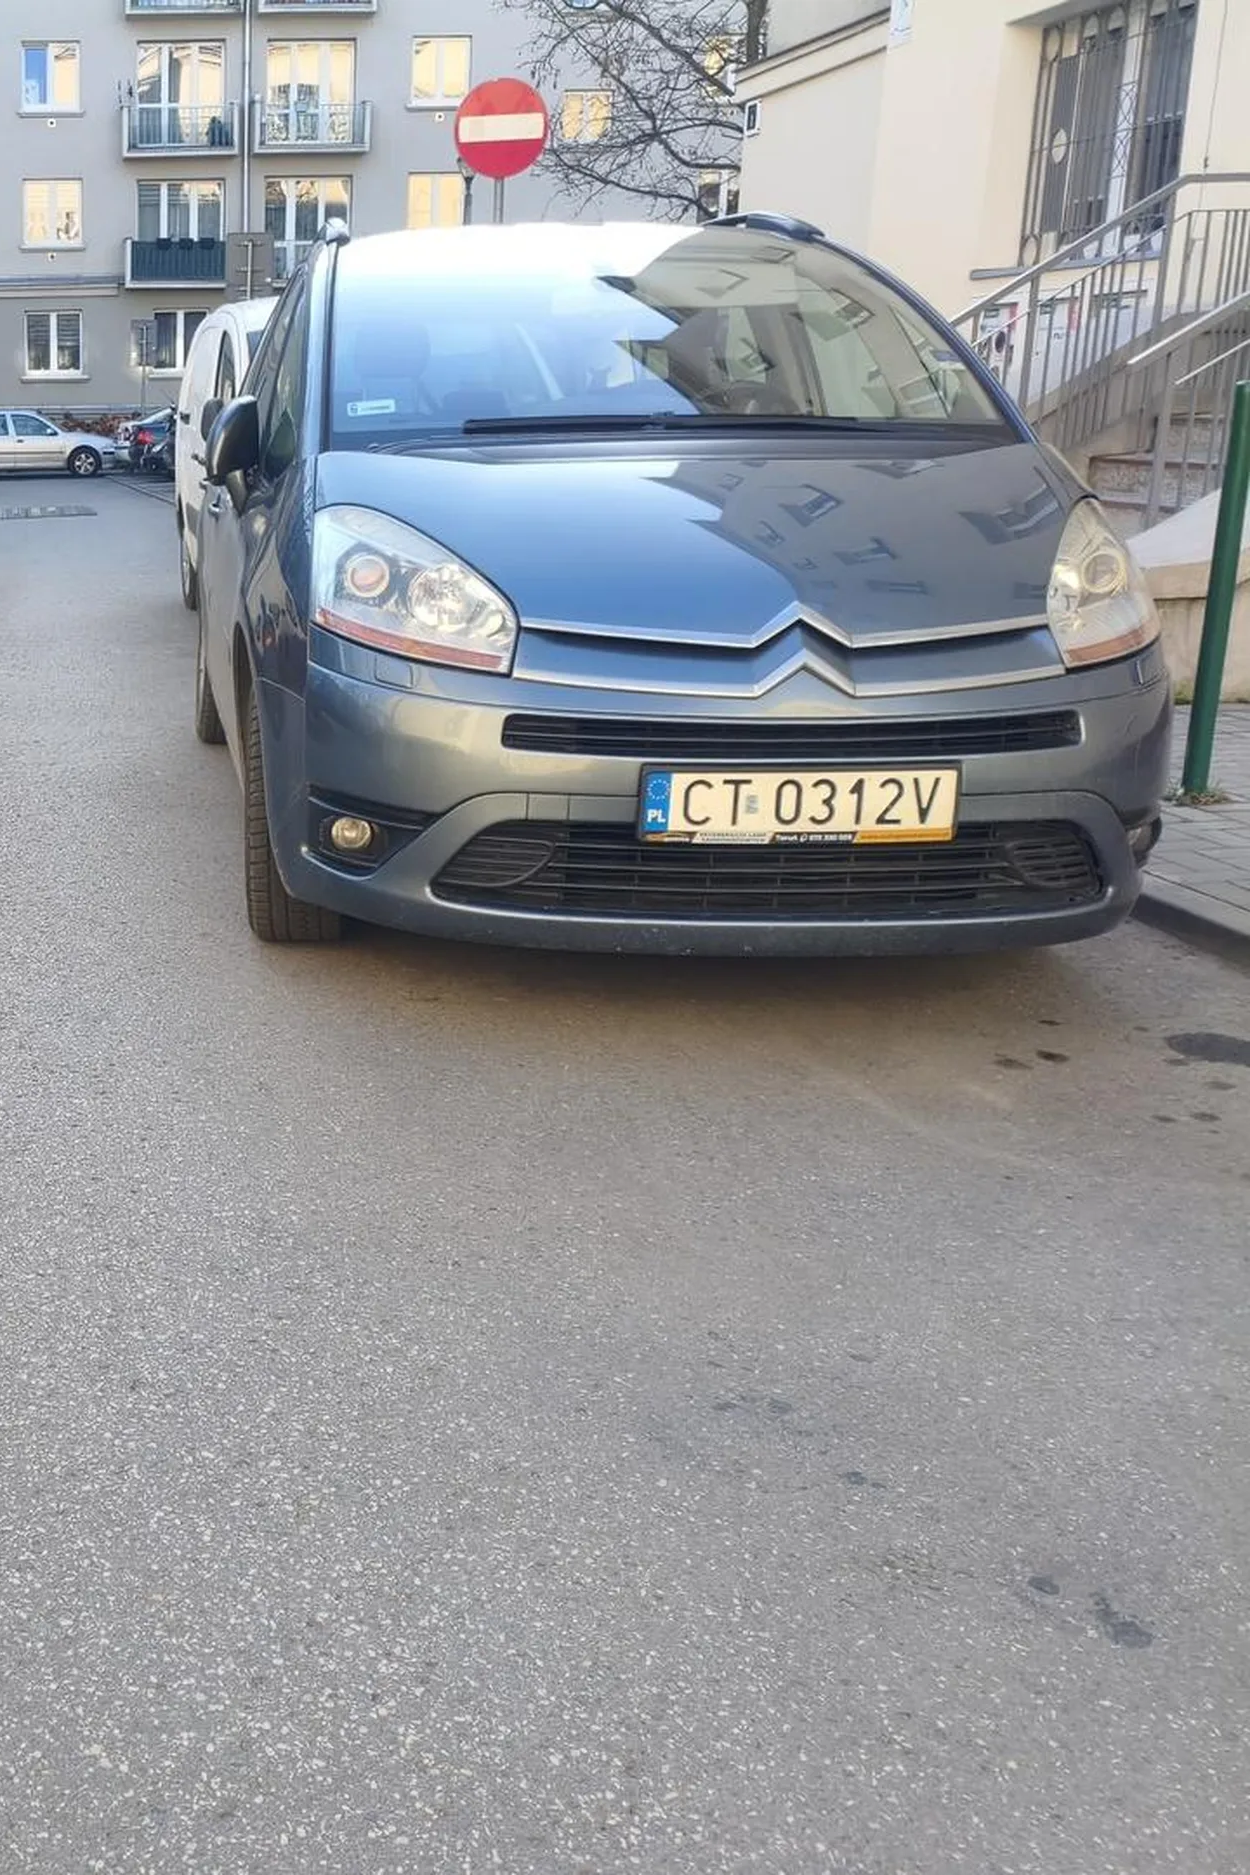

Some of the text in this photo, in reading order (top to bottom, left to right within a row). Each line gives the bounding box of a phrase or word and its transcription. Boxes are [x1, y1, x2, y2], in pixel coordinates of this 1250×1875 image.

[647, 809, 666, 823] PL
[682, 777, 941, 826] CT 0312V
